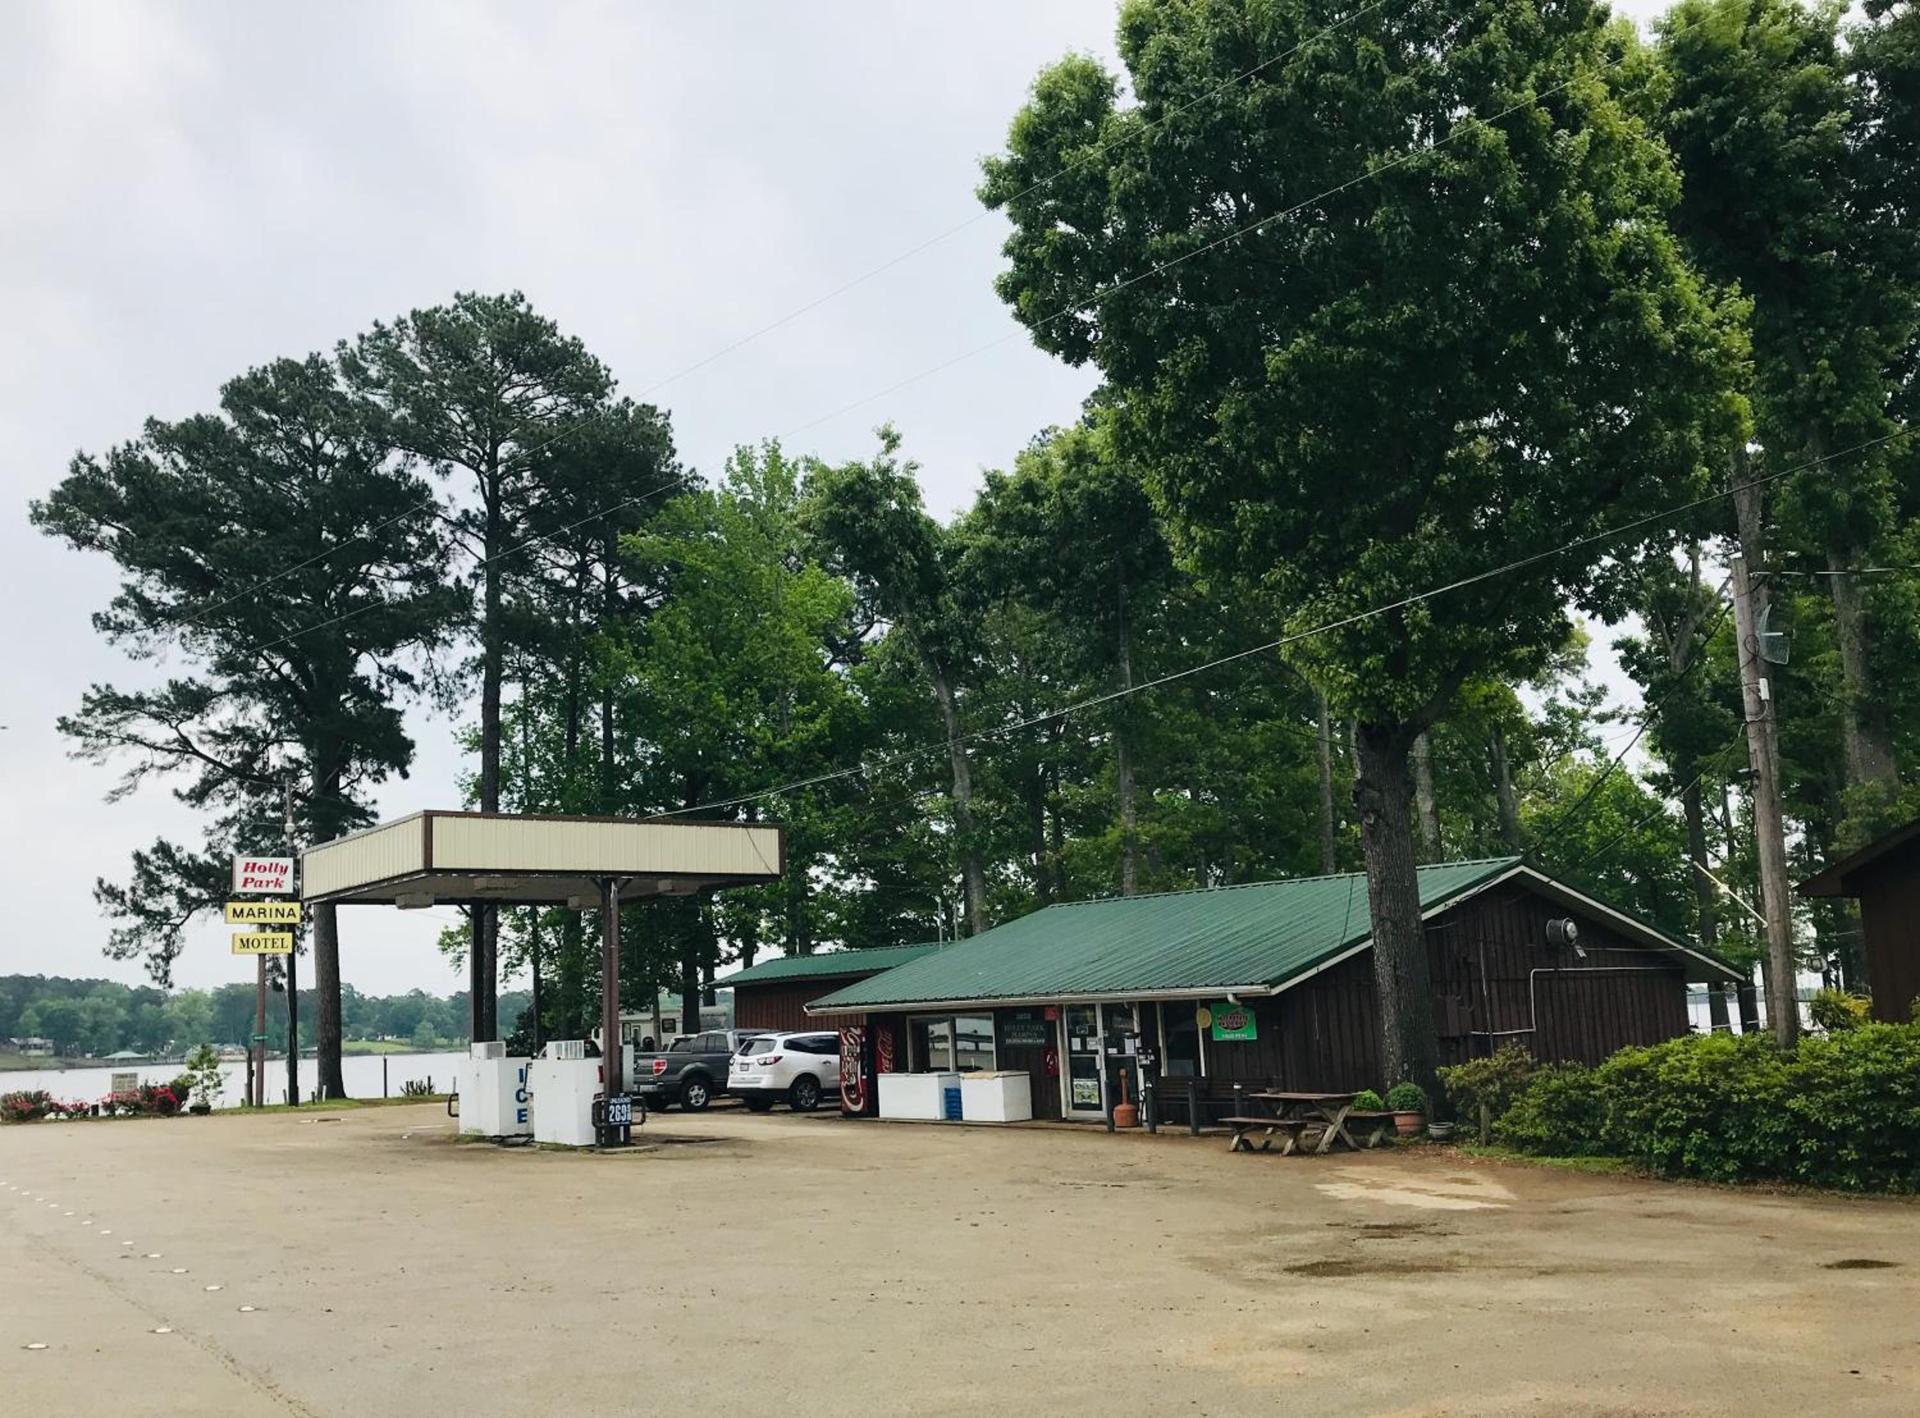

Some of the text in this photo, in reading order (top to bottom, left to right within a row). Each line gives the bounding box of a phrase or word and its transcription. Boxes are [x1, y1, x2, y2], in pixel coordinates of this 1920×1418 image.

[242, 862, 289, 876] Holly
[241, 877, 284, 888] Park
[232, 907, 297, 919] MARINA
[239, 938, 289, 949] MOTEL
[515, 1068, 528, 1123] ICE
